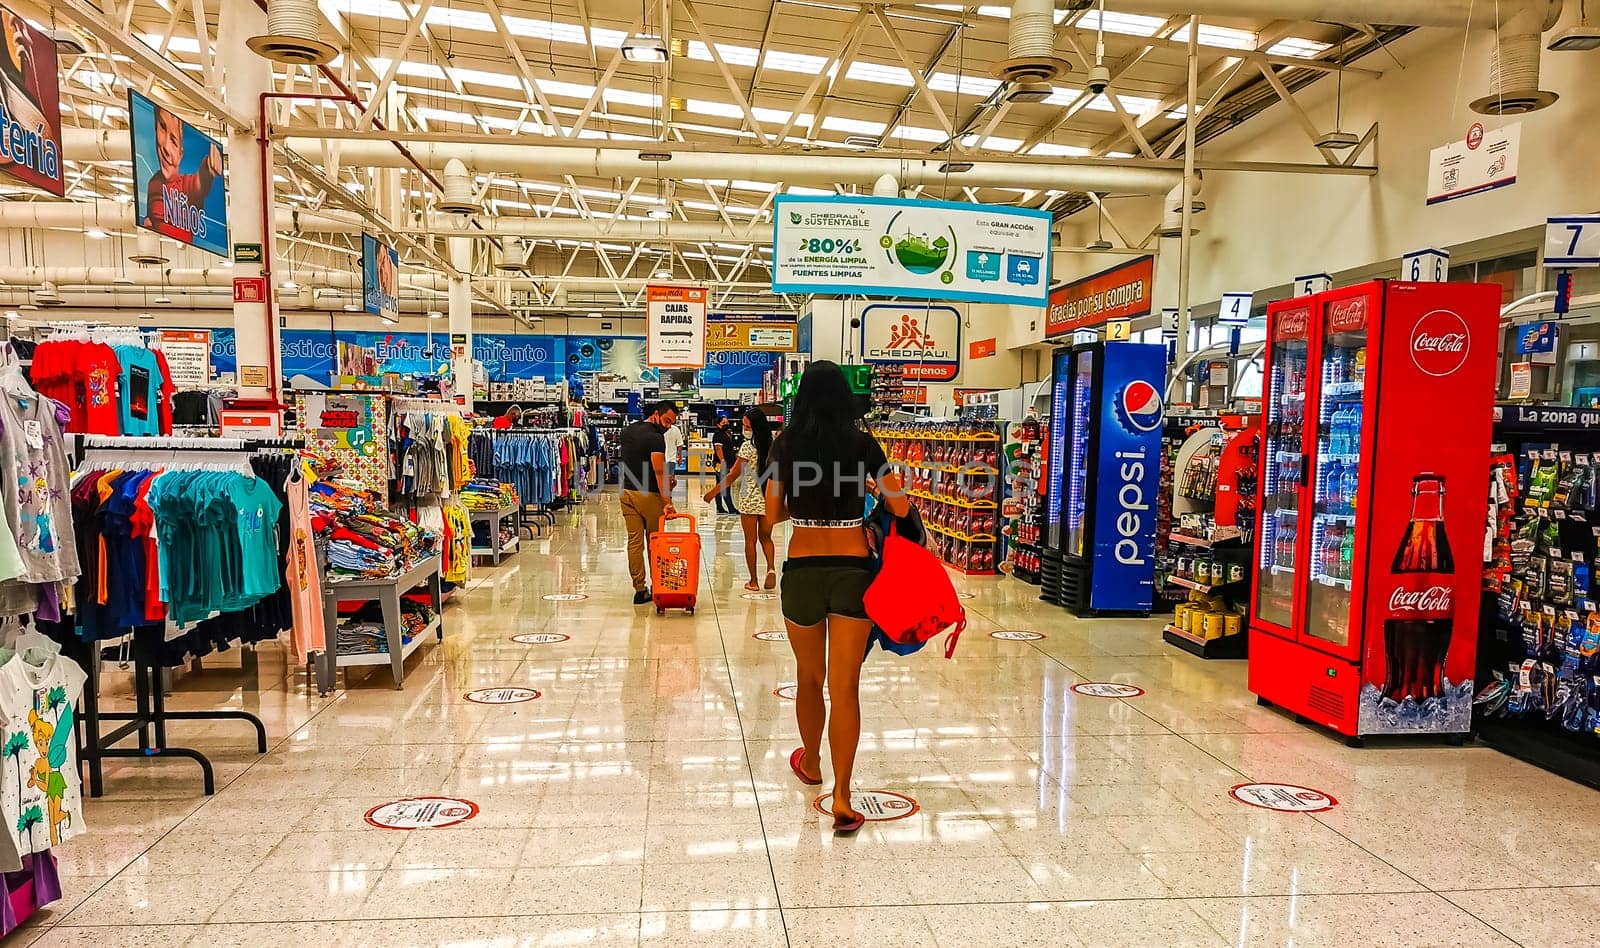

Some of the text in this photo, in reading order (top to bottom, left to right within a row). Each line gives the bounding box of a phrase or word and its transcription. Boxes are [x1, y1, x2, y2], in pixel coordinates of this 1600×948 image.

[162, 184, 207, 239] Niños
[805, 218, 870, 227] SUSTENTABLE
[808, 238, 853, 254] 80%
[1566, 225, 1583, 256] 7
[804, 256, 839, 264] ENERGÍA
[1411, 257, 1420, 281] 6
[1435, 257, 1442, 282] 6
[665, 304, 688, 313] CAJAS
[1050, 279, 1143, 323] Gracias por su compra
[1231, 298, 1240, 317] 4
[660, 315, 693, 324] RAPIDAS
[720, 324, 737, 338] 12
[1114, 323, 1122, 339] 2
[1414, 332, 1466, 352] Coca-Cola
[374, 341, 547, 362] Entretemiento
[870, 349, 948, 358] CHEDRAUI
[911, 367, 947, 375] menos
[1178, 417, 1190, 426] La
[1519, 407, 1538, 422] La
[1541, 409, 1577, 423] zona
[1115, 451, 1149, 566] pepsi
[1389, 586, 1452, 611] Coca-Cola
